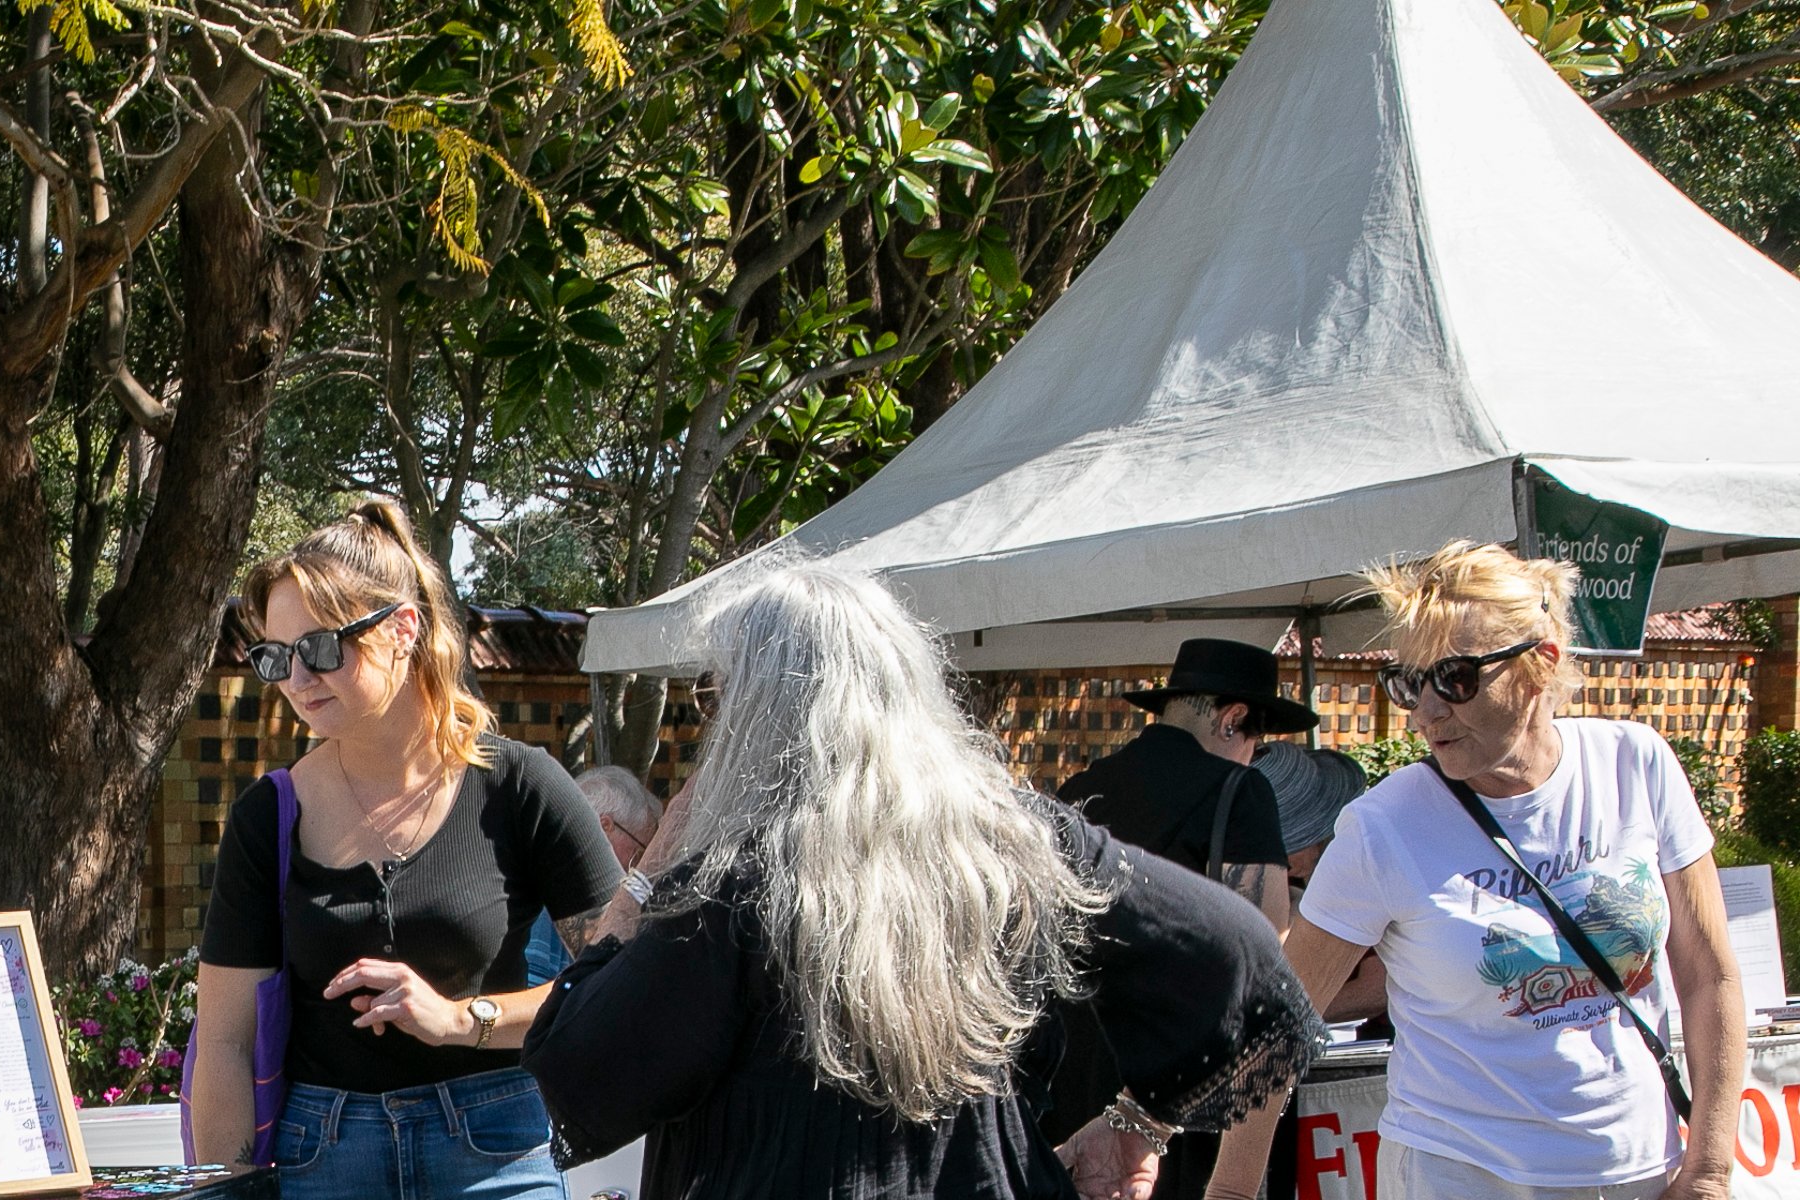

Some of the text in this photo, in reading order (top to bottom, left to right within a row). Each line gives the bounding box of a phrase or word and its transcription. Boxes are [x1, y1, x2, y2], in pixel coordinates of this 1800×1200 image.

[1536, 532, 1643, 565] Friends of
[1532, 1010, 1579, 1031] Ultimate
